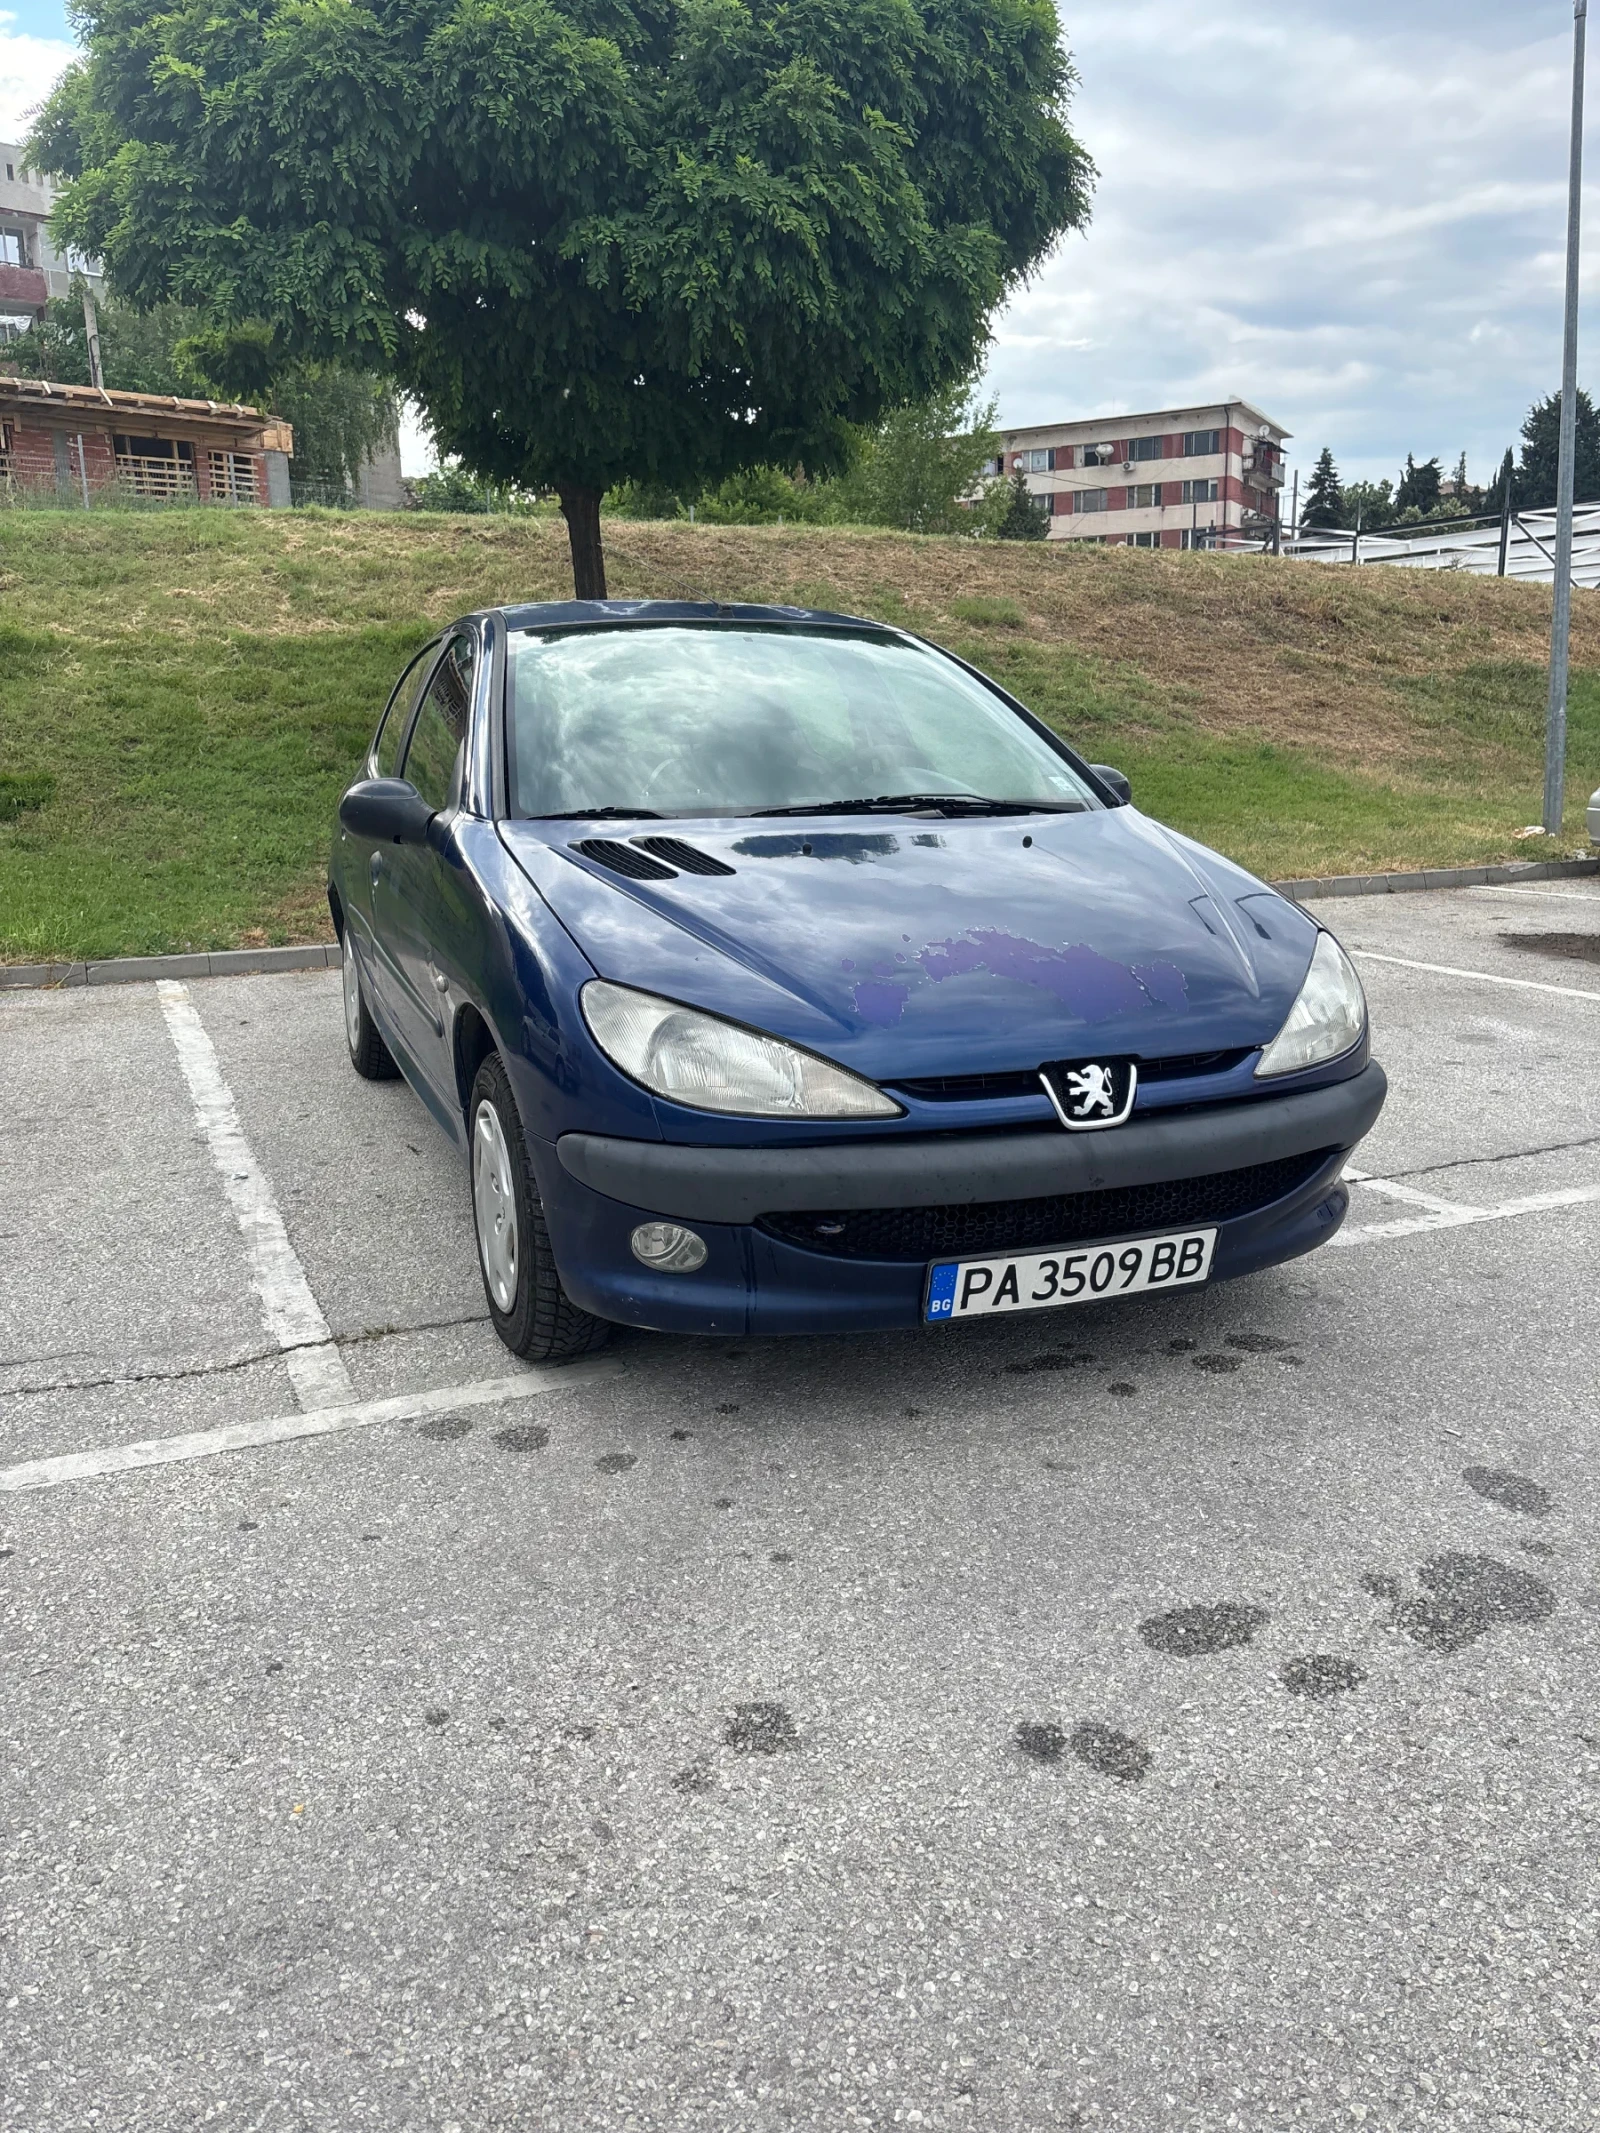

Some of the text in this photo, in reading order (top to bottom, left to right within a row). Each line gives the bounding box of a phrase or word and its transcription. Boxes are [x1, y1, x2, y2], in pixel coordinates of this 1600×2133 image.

[960, 1237, 1205, 1309] PA 3509 BB
[931, 1299, 951, 1312] BG
